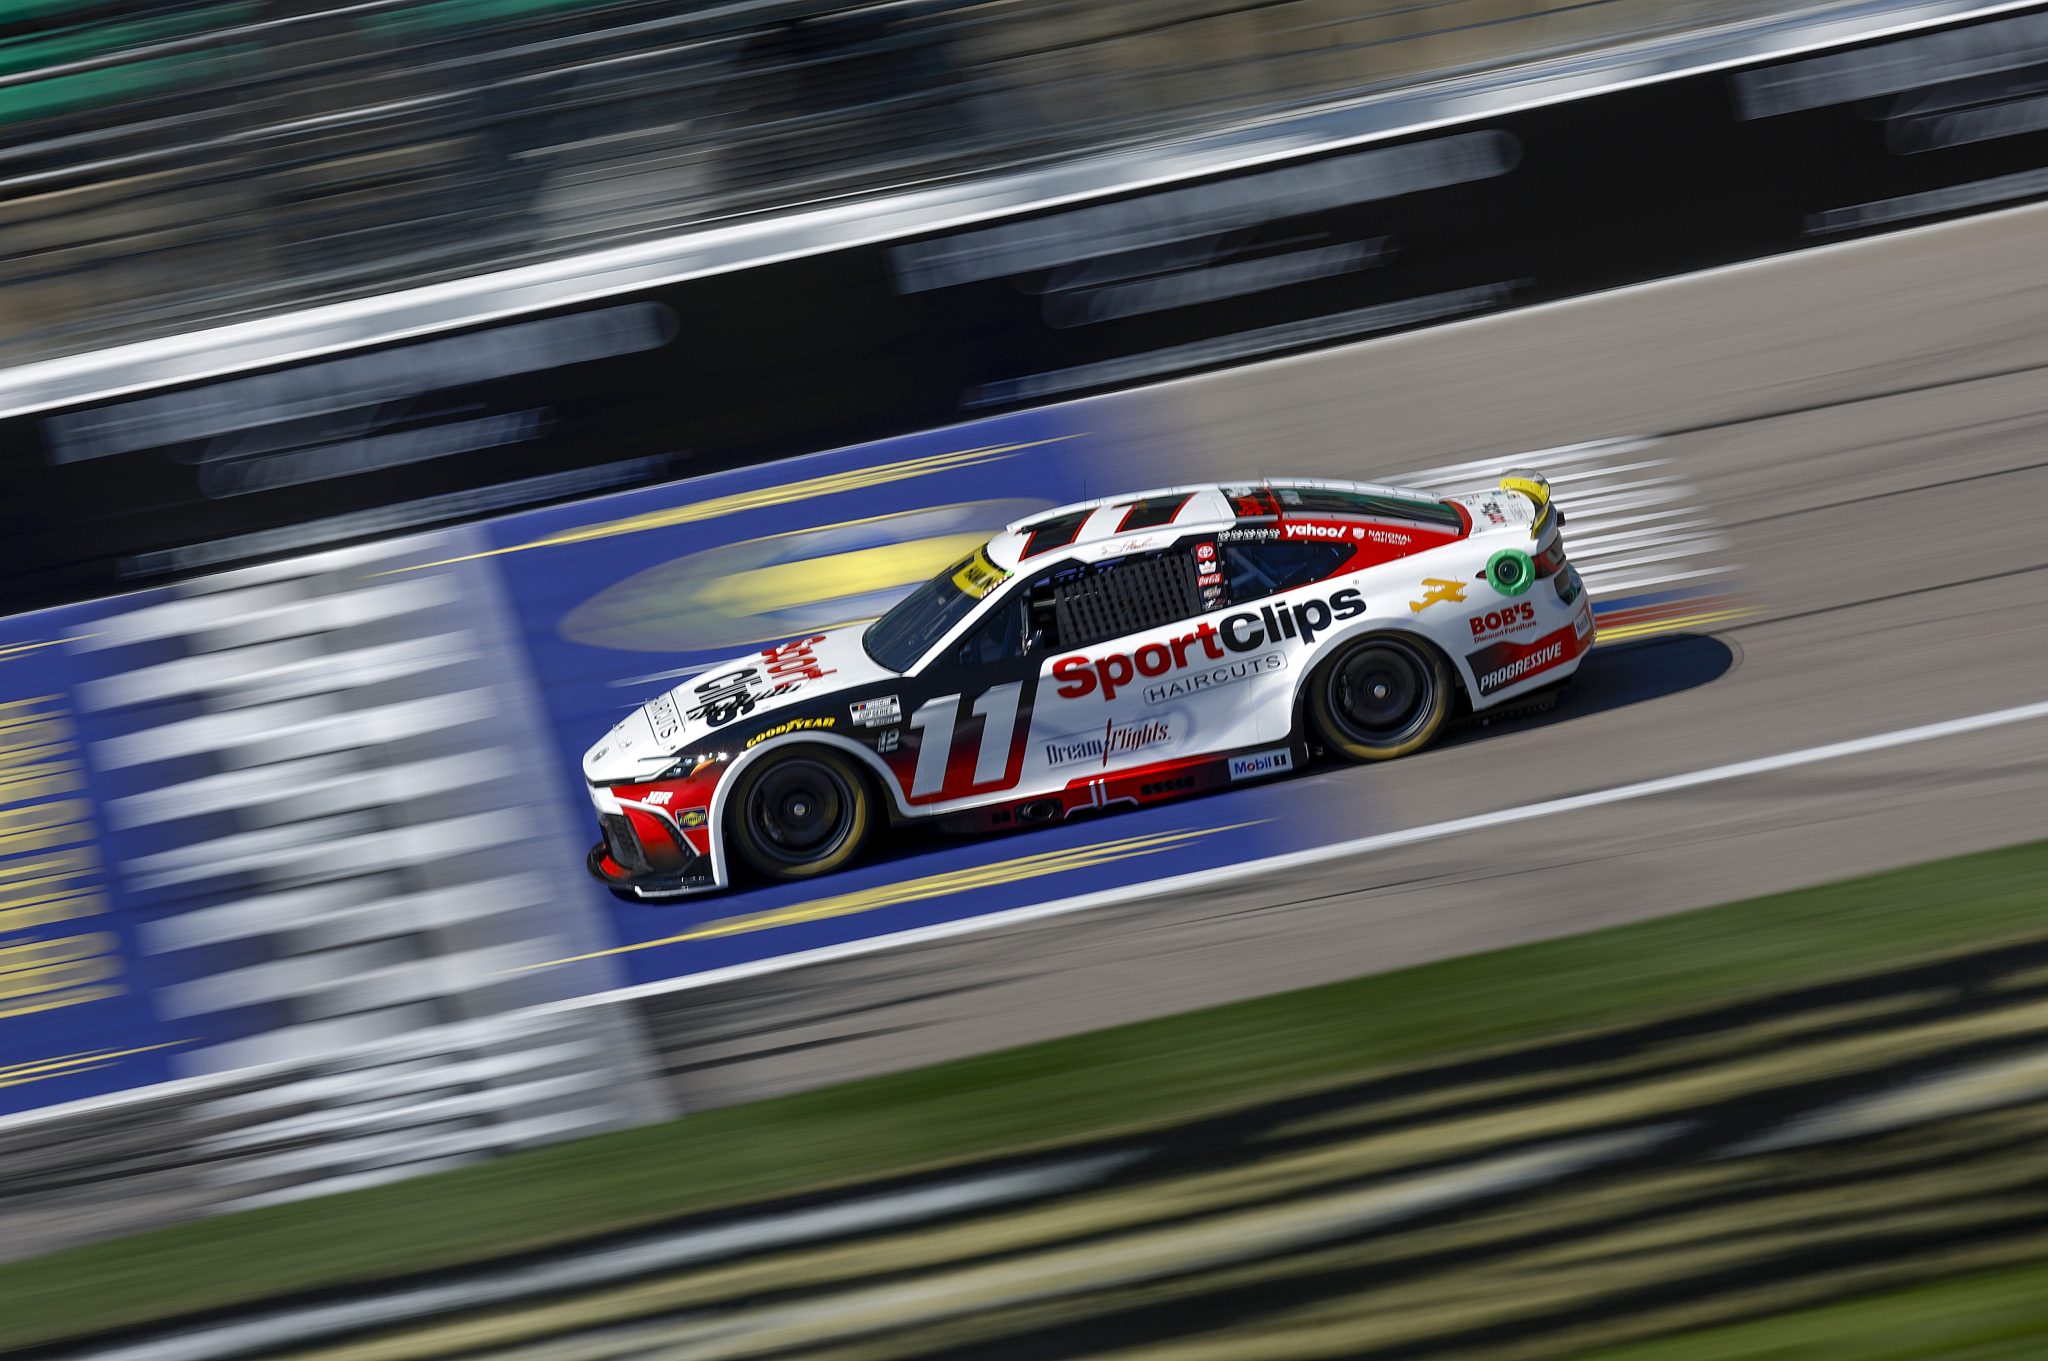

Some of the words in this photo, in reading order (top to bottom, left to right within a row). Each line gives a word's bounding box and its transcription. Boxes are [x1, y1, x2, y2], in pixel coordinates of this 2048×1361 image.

[1285, 523, 1347, 538] yahoo!
[1368, 529, 1411, 543] NATIONAL
[1470, 600, 1535, 635] BOB'S
[1474, 629, 1504, 643] Discount
[1505, 620, 1537, 635] Furniture
[1148, 655, 1282, 702] HAIRCUTS
[1480, 641, 1562, 693] PROGRESSIVE
[746, 717, 836, 749] GOODYEAR
[910, 681, 1023, 799] 11
[1046, 739, 1103, 765] Dream
[1234, 757, 1272, 775] Mobil
